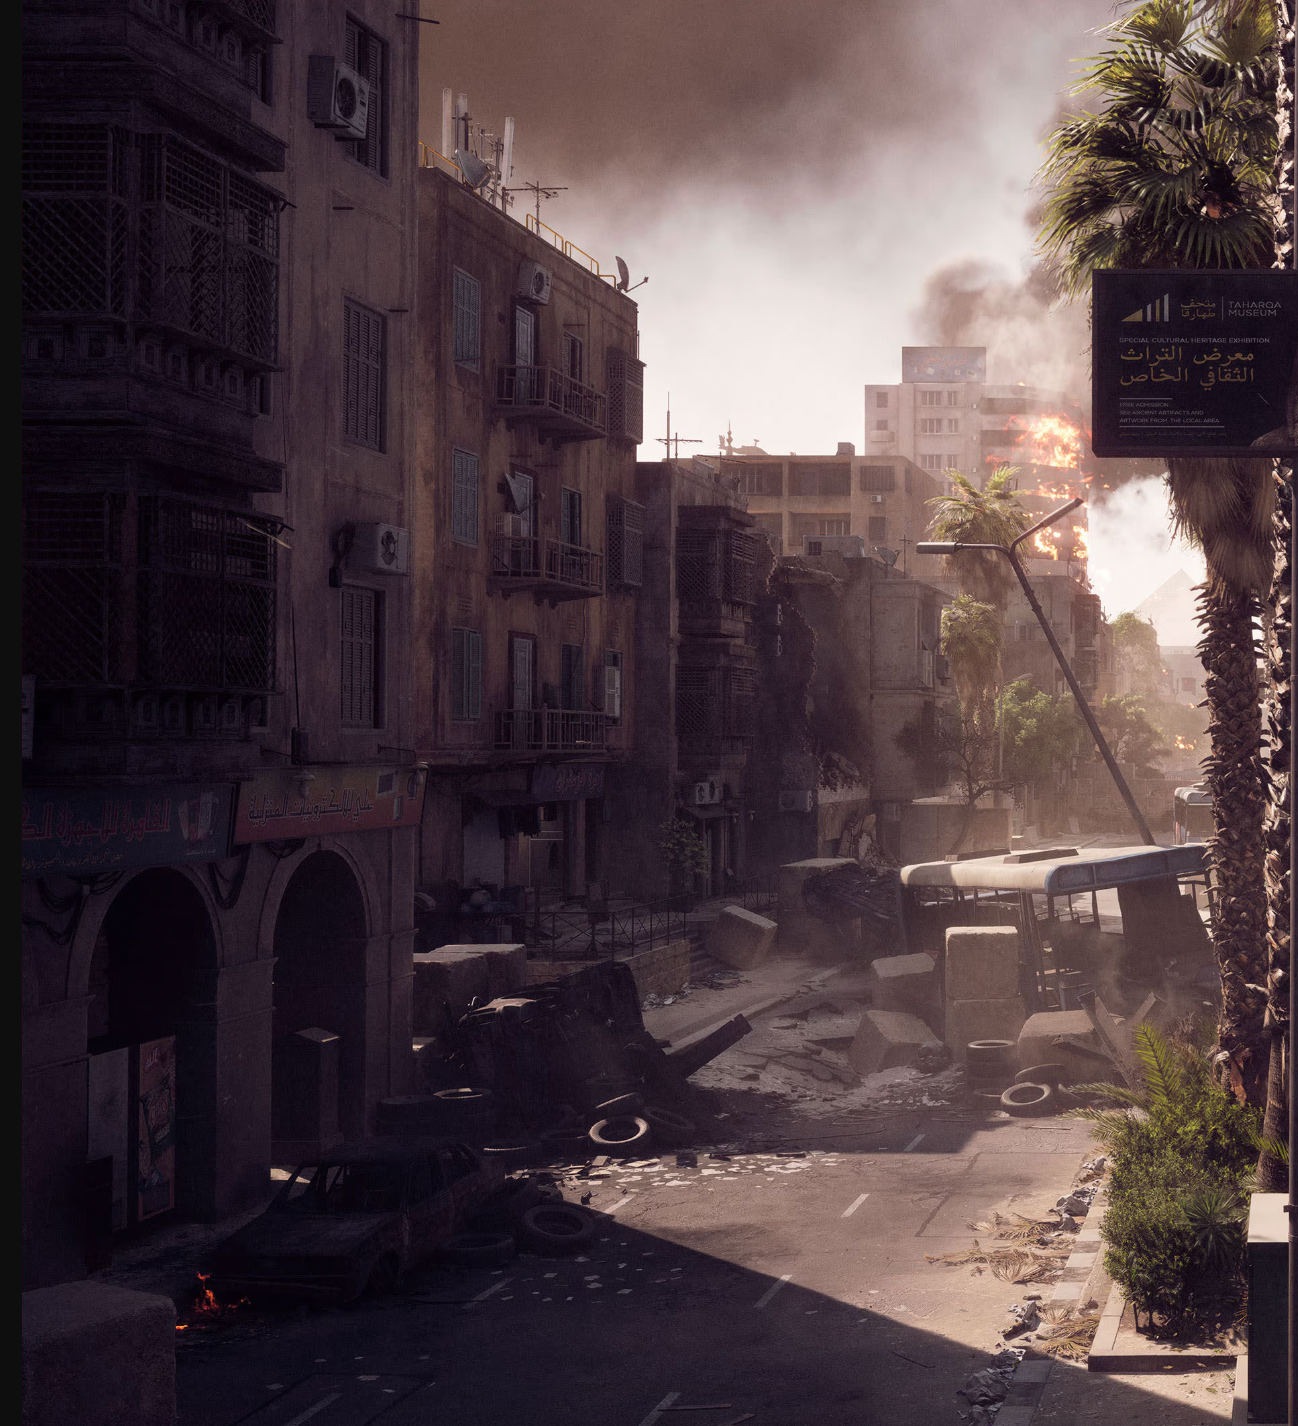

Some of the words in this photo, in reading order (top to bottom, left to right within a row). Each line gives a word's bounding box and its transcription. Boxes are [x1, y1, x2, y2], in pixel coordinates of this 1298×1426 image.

[1180, 298, 1216, 309] متحف
[1228, 301, 1282, 309] TAHARQA
[1228, 309, 1277, 317] MUSEUM
[1180, 308, 1216, 320] طهارقا
[1120, 345, 1182, 367] التراث
[1193, 347, 1254, 367] معرض
[1120, 366, 1189, 386] الخاص
[1199, 366, 1254, 391] الثقافي
[247, 791, 289, 827] المنزلية
[353, 788, 374, 822] علي
[120, 798, 171, 842] القاهرة
